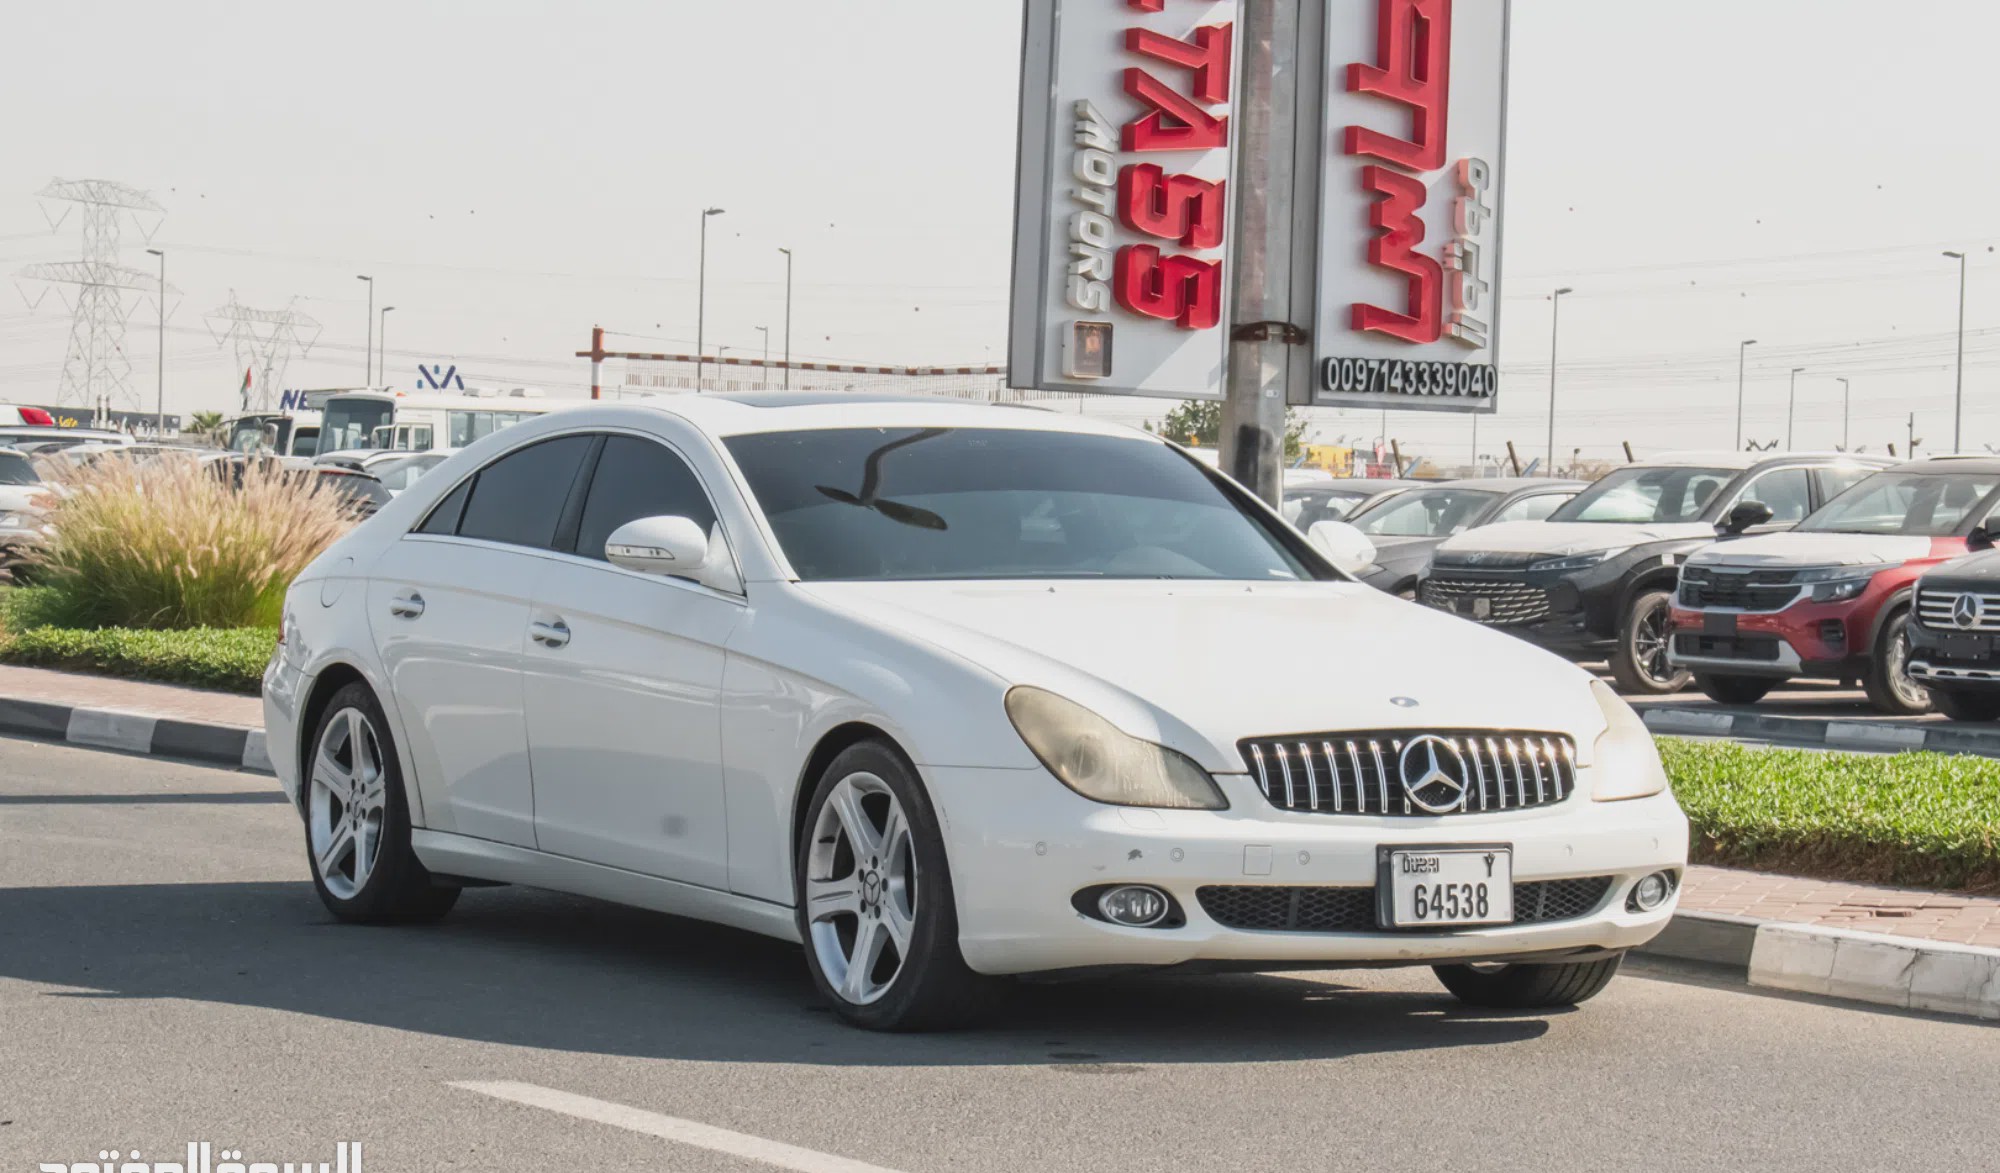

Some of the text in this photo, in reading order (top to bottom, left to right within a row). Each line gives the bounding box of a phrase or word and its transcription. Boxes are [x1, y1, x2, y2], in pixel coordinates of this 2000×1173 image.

[1114, 0, 1234, 330] TASS
[1066, 98, 1119, 313] MOTORS
[1325, 357, 1497, 397] 0097143339040
[1483, 853, 1496, 877] Y
[1414, 882, 1489, 919] 64538
